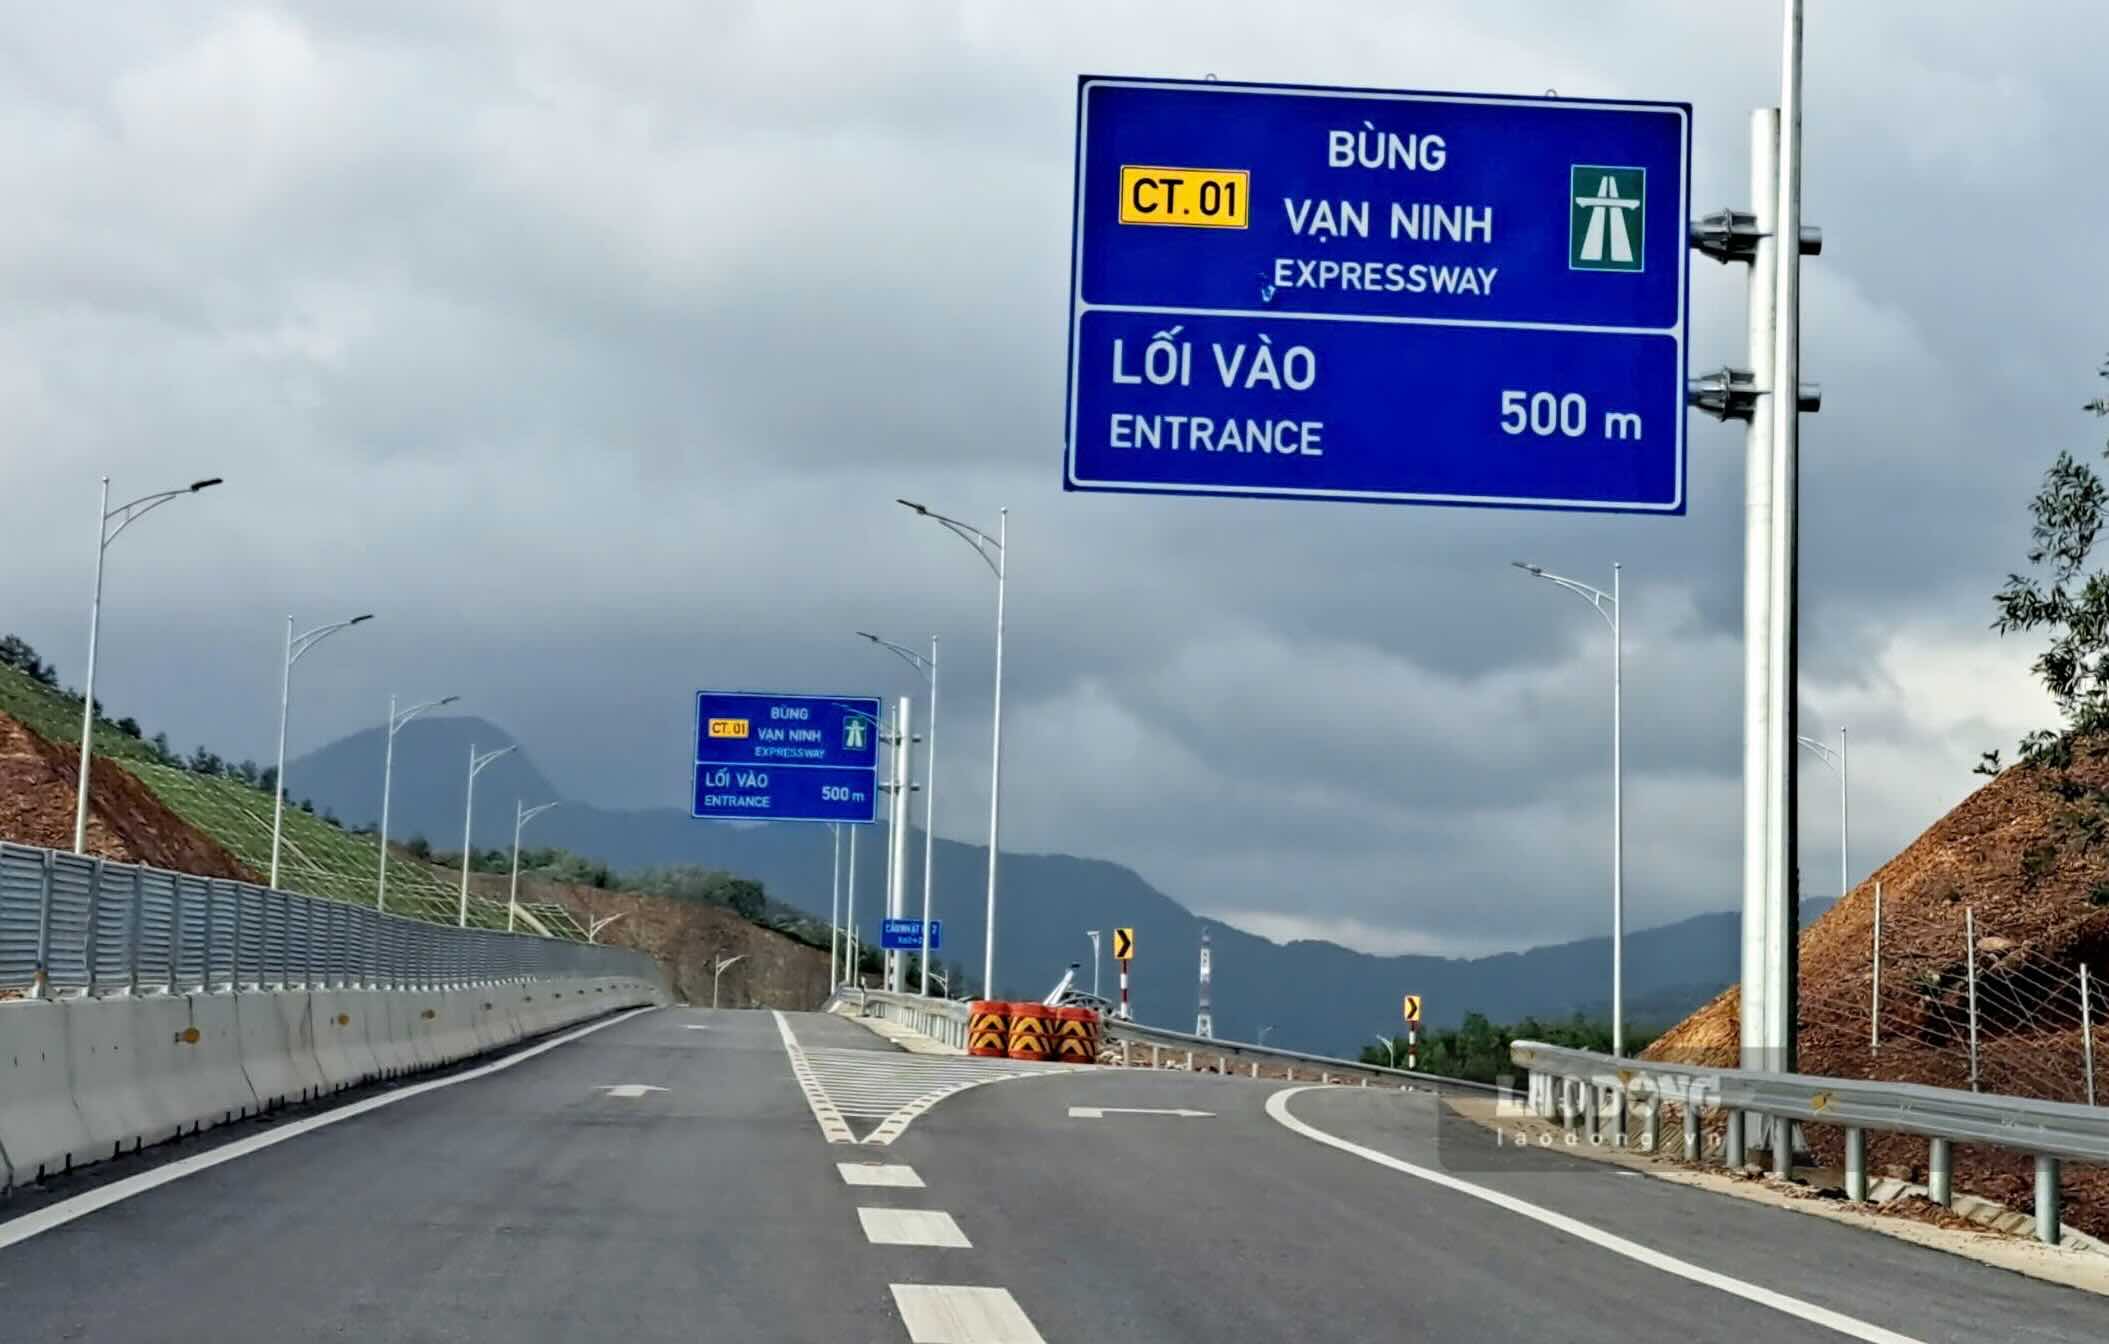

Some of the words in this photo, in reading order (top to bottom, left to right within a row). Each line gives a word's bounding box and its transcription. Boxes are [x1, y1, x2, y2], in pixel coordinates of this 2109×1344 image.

[1328, 121, 1447, 172] BÙNG
[1284, 198, 1369, 243] VẠN
[1390, 203, 1493, 243] NINH
[1273, 258, 1498, 296] EXPRESSWAY
[1111, 326, 1191, 387] LỐI
[1212, 334, 1317, 391] VÀO
[1500, 390, 1588, 438] 500
[1604, 411, 1642, 440] m
[1109, 413, 1324, 456] ENTRANCE
[770, 705, 809, 720] BÙNG
[758, 727, 784, 743] VẠN
[788, 729, 822, 742] NINH
[754, 746, 825, 759] EXPRESSWAY
[705, 768, 730, 787] LỐI
[735, 770, 768, 788] VÀO
[704, 794, 771, 808] ENTRANCE
[821, 785, 849, 800] 500
[852, 791, 865, 802] m
